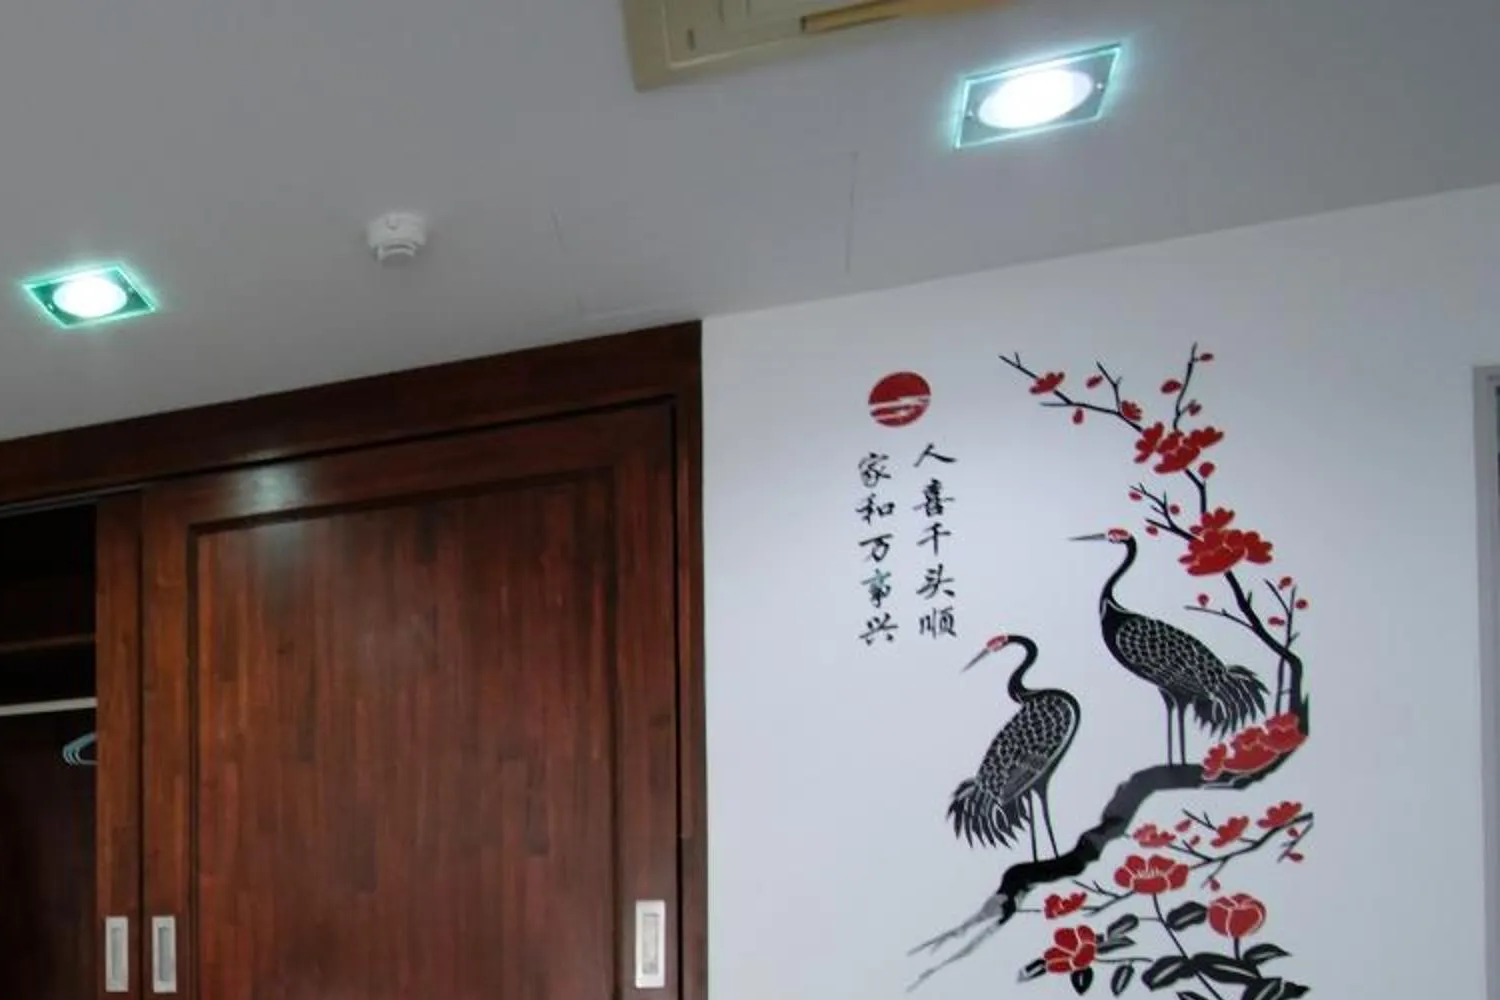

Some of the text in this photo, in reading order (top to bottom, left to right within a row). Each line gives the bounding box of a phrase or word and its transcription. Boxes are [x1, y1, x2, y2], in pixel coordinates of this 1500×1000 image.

[855, 451, 899, 645] 家和万事兴
